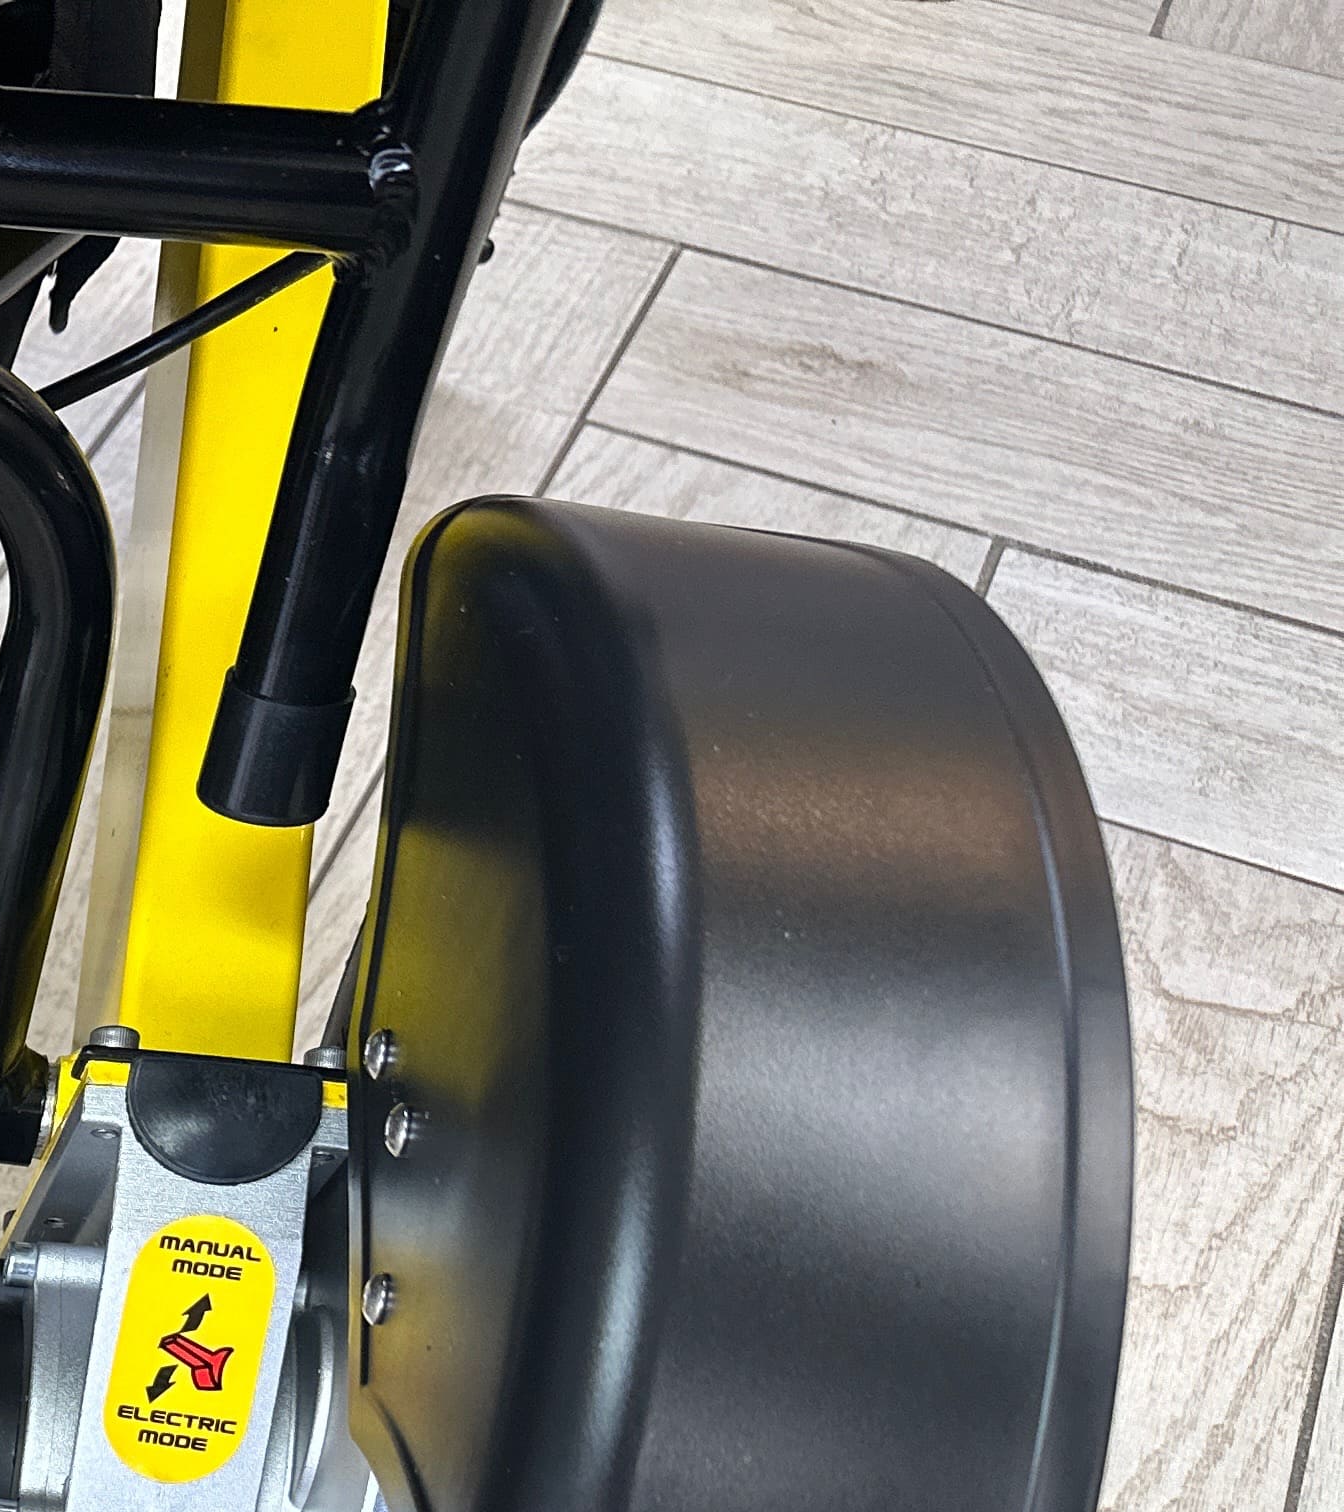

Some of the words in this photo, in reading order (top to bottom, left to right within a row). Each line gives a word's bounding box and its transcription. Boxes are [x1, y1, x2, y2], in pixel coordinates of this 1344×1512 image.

[159, 1235, 262, 1262] MANUAL
[172, 1259, 243, 1281] MODE
[117, 1404, 237, 1434] ELECTRIC
[138, 1429, 208, 1452] MODE
